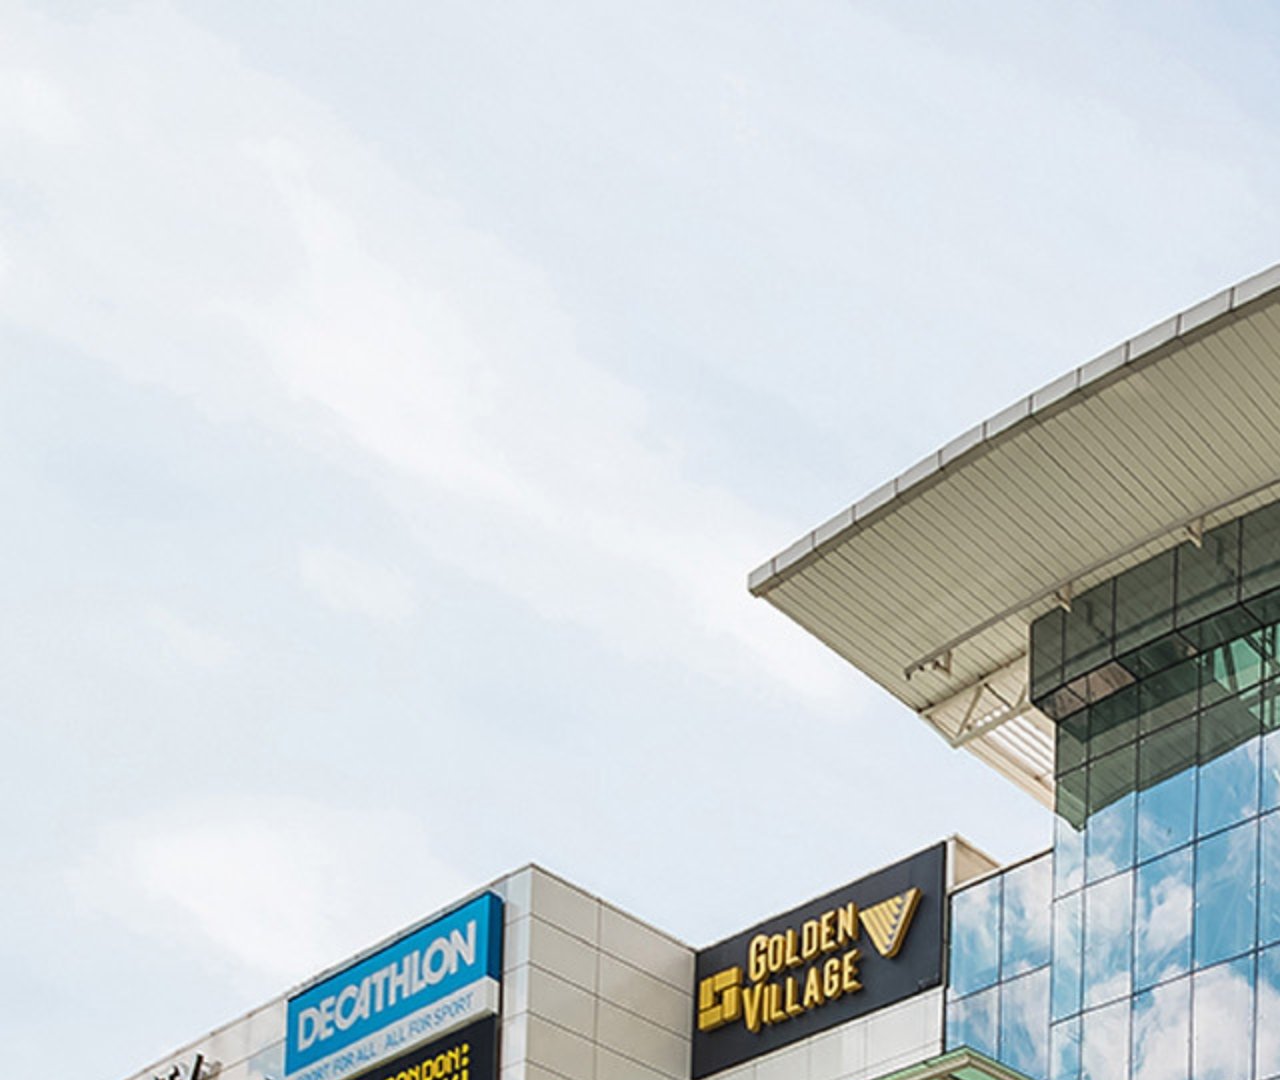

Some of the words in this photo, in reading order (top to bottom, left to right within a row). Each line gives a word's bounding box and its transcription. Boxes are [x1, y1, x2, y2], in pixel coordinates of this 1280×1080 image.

[749, 901, 860, 982] GOLDEN
[298, 919, 477, 1051] DECATHLON
[742, 949, 864, 1033] VILLAGE
[331, 1053, 355, 1076] FOR
[356, 1041, 376, 1062] ALL
[384, 1026, 406, 1050] ALL
[408, 1014, 432, 1037] FOR
[433, 991, 473, 1025] SPORT
